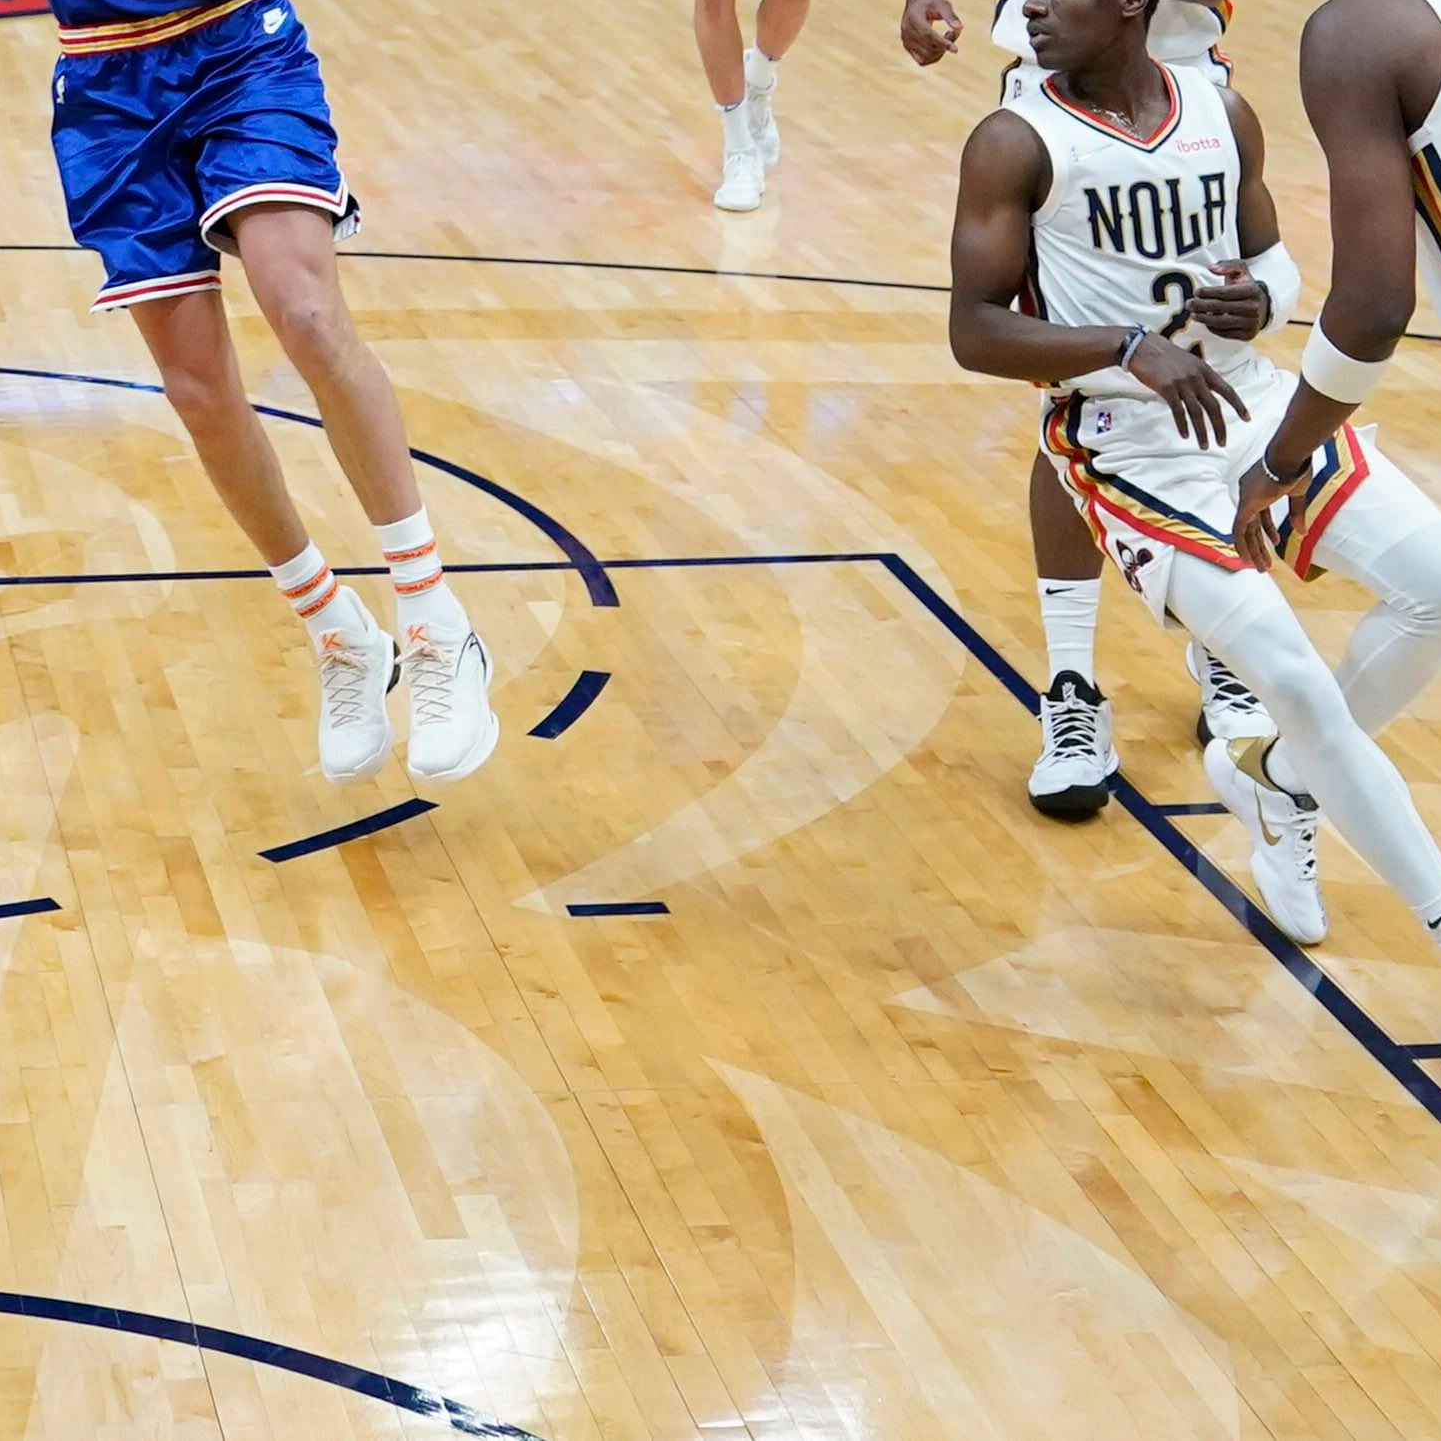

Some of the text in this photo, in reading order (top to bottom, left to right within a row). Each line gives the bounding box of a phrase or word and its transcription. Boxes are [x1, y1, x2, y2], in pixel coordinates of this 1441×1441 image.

[1176, 138, 1222, 154] ibotta
[1082, 171, 1226, 260] NOLA
[1150, 267, 1205, 361] 2
